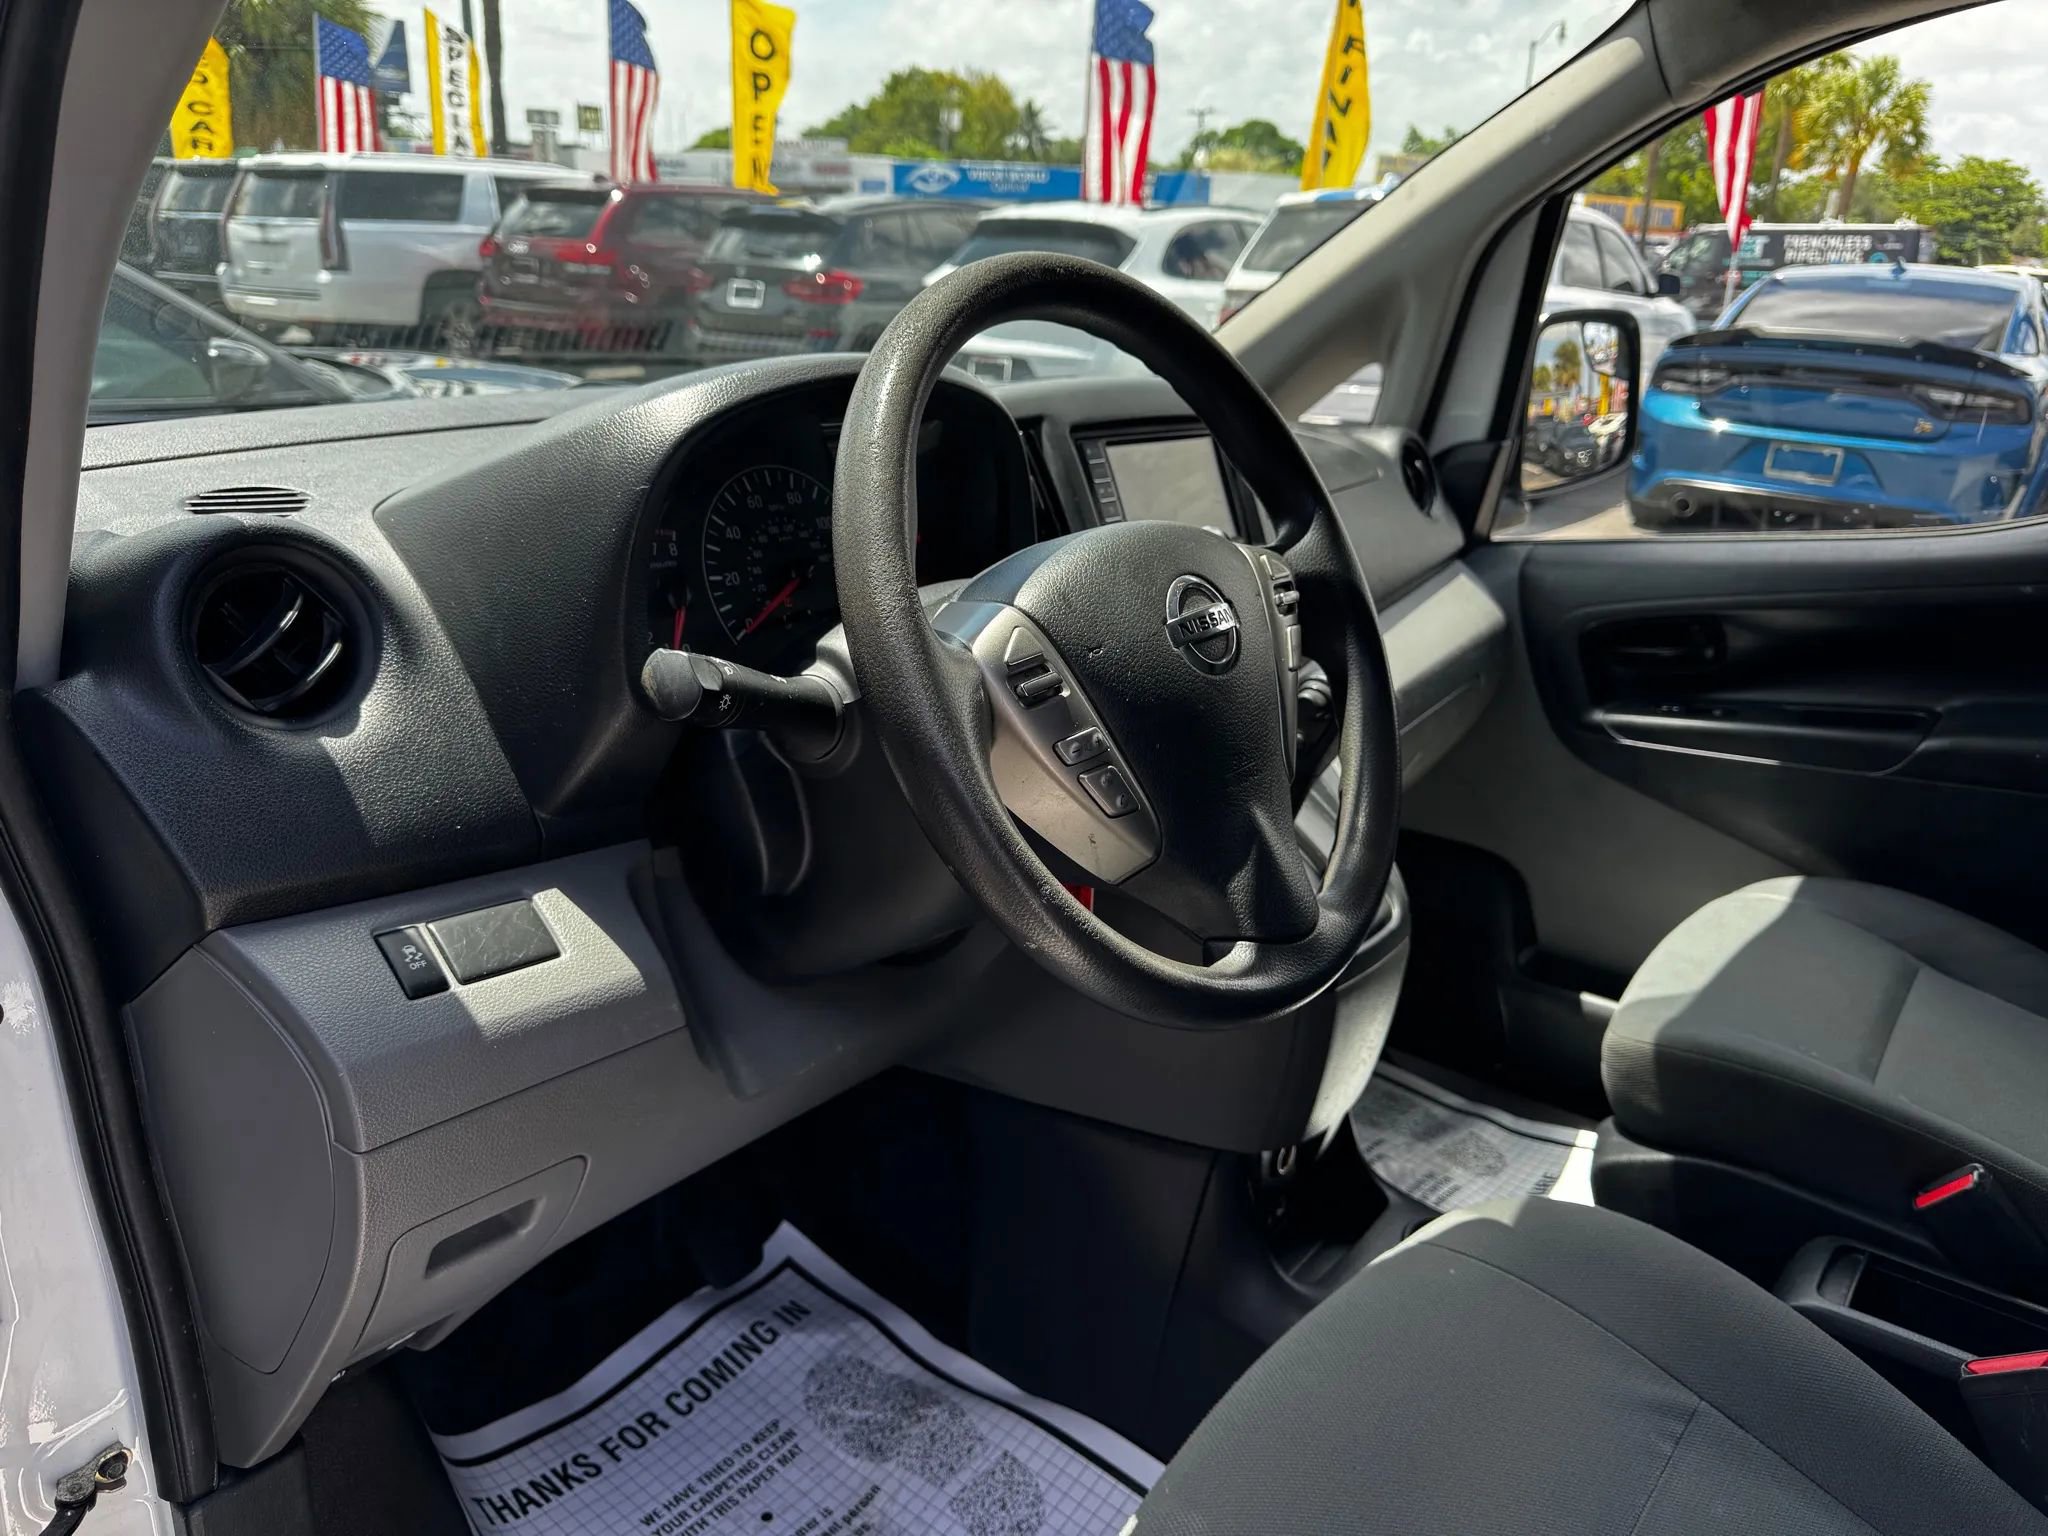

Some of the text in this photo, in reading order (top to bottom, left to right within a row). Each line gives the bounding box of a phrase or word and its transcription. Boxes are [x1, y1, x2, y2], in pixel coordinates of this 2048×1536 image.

[750, 31, 775, 183] OPEN
[725, 526, 741, 540] 40
[725, 571, 740, 586] 20
[1178, 606, 1235, 638] NISSAN
[409, 960, 428, 971] OFF
[473, 1299, 812, 1526] THANKS FOR COMING IN
[640, 1418, 781, 1528] WE HAVE TRIED TO KEEP
[652, 1428, 798, 1536] YOUR CARPETING CLEAN
[707, 1496, 741, 1524] THIS
[740, 1465, 779, 1500] PAPER
[778, 1441, 805, 1469] MAT
